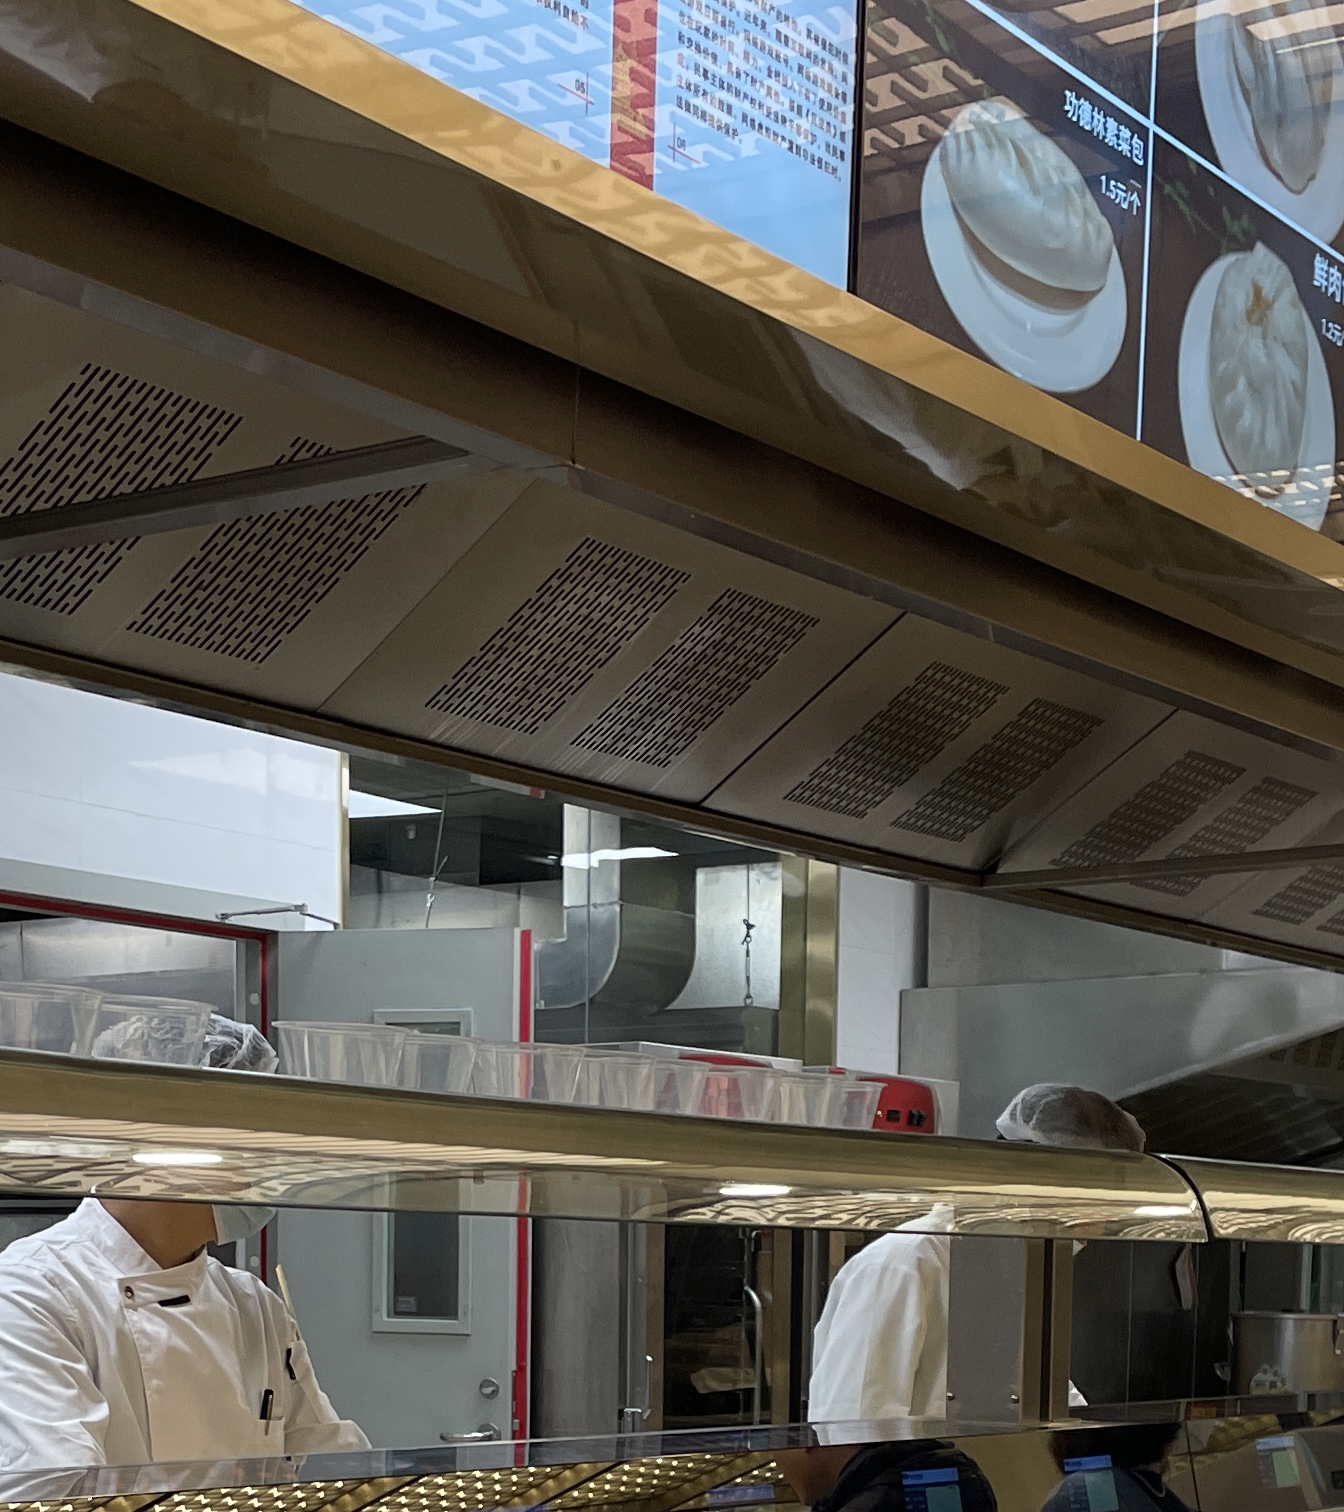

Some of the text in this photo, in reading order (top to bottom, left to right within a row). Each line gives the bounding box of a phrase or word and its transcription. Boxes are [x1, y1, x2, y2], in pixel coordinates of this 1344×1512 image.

[1064, 90, 1145, 166] 功德林素菜包
[1100, 174, 1142, 216] 1.5元/个
